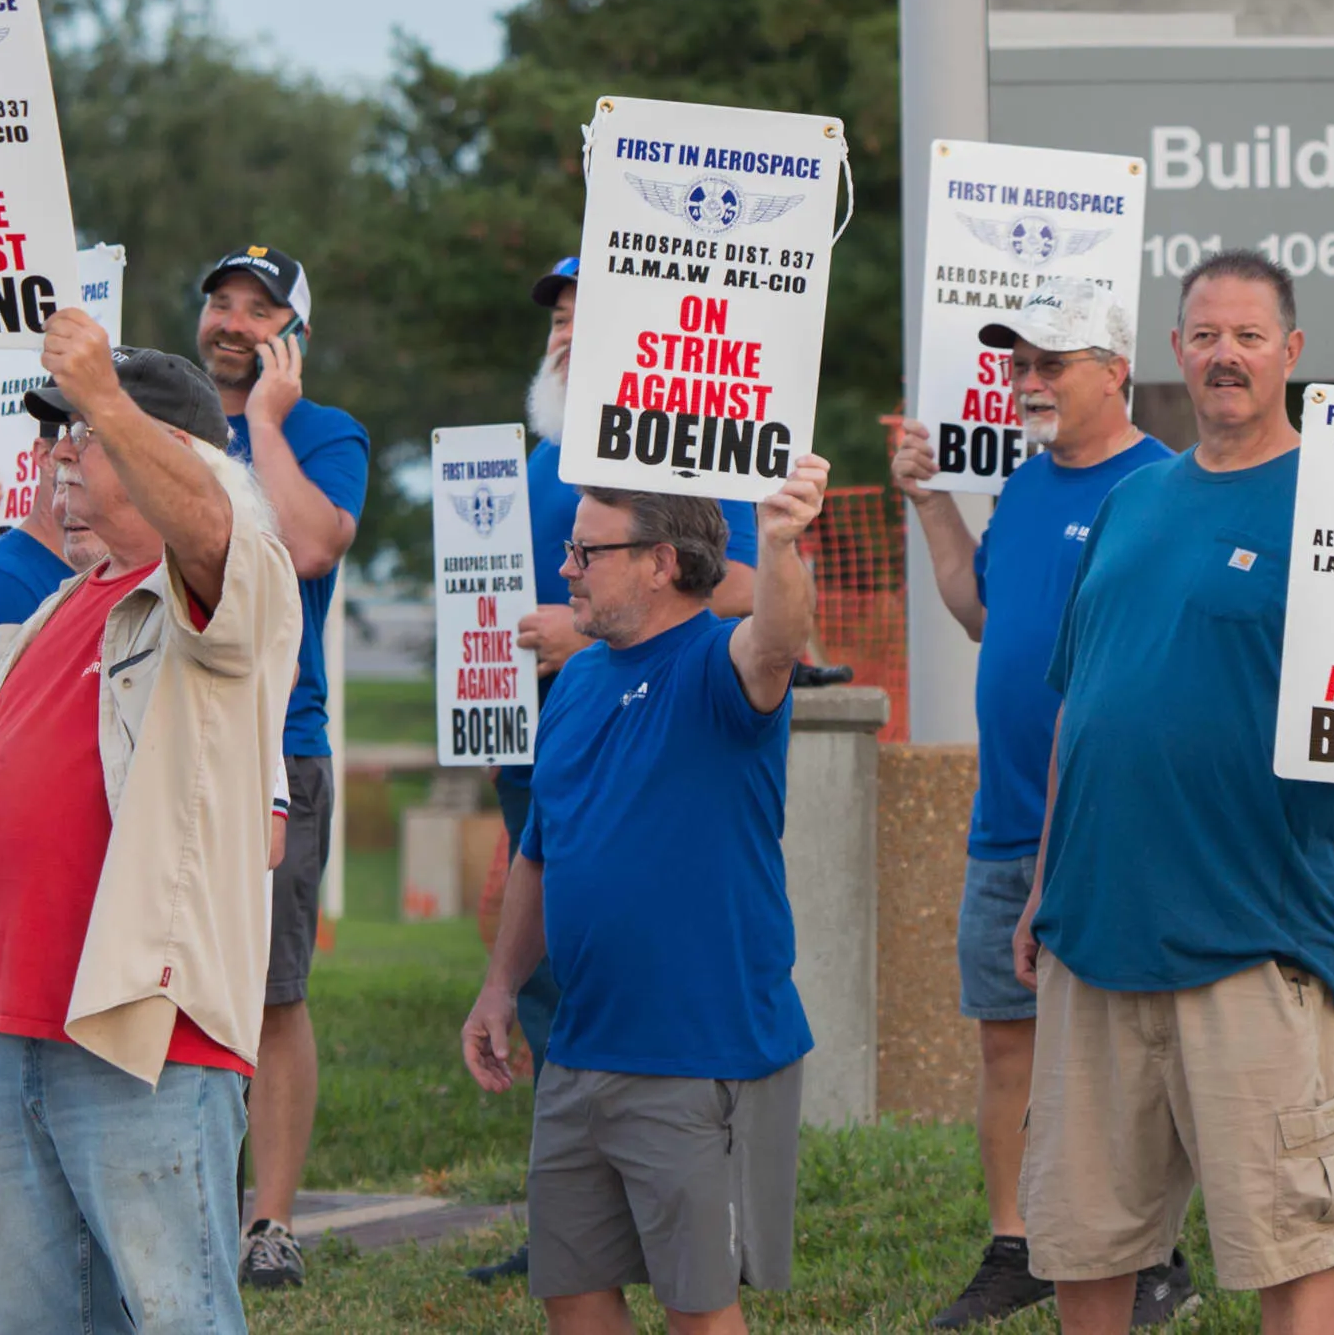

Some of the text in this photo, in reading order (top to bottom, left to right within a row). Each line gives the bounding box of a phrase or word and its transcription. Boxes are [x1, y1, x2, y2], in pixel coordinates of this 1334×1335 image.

[616, 138, 821, 180] FIRST IN AEROSPACE
[948, 180, 1125, 216] FIRST IN AEROSPACE
[608, 231, 814, 270] AEROSPACE DIST. 837
[724, 269, 806, 294] AFL-CIO
[936, 266, 1029, 289] AEROSPACE
[679, 295, 728, 335] ON
[636, 331, 762, 379] STRIKE
[1, 376, 51, 395] AEROSP
[616, 371, 773, 422] AGAINST
[597, 404, 791, 479] BOEING
[443, 459, 518, 481] FIRST IN AEROSPACE
[477, 596, 496, 628] ON
[463, 631, 513, 664] STRIKE
[457, 667, 518, 701] AGAINST
[452, 705, 528, 756] BOEING
